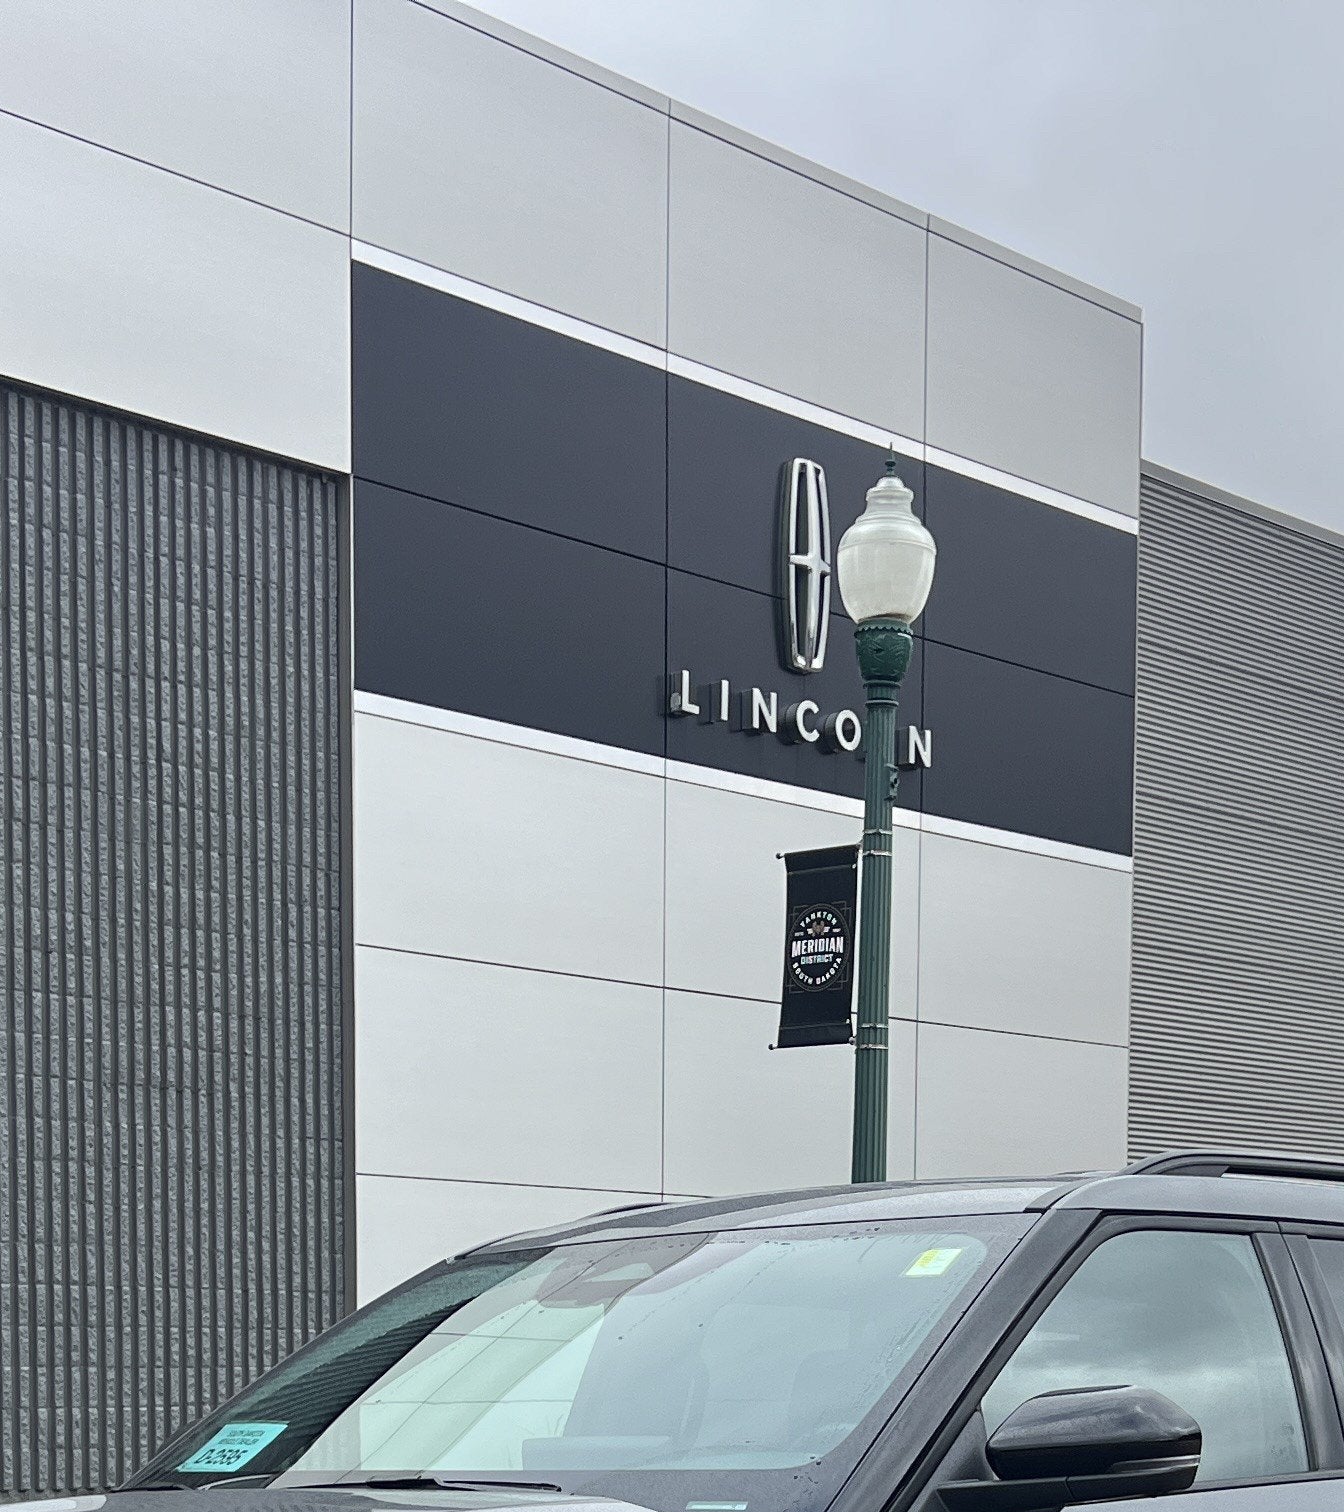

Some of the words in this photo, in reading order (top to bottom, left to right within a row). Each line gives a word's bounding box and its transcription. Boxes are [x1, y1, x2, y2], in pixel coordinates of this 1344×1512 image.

[672, 669, 932, 768] LINCON
[800, 911, 837, 928] YANKTON
[791, 937, 844, 958] MERIDIAN
[800, 954, 834, 965] DISTRICT
[792, 962, 814, 985] SOUTH
[816, 957, 842, 985] DAKOTA
